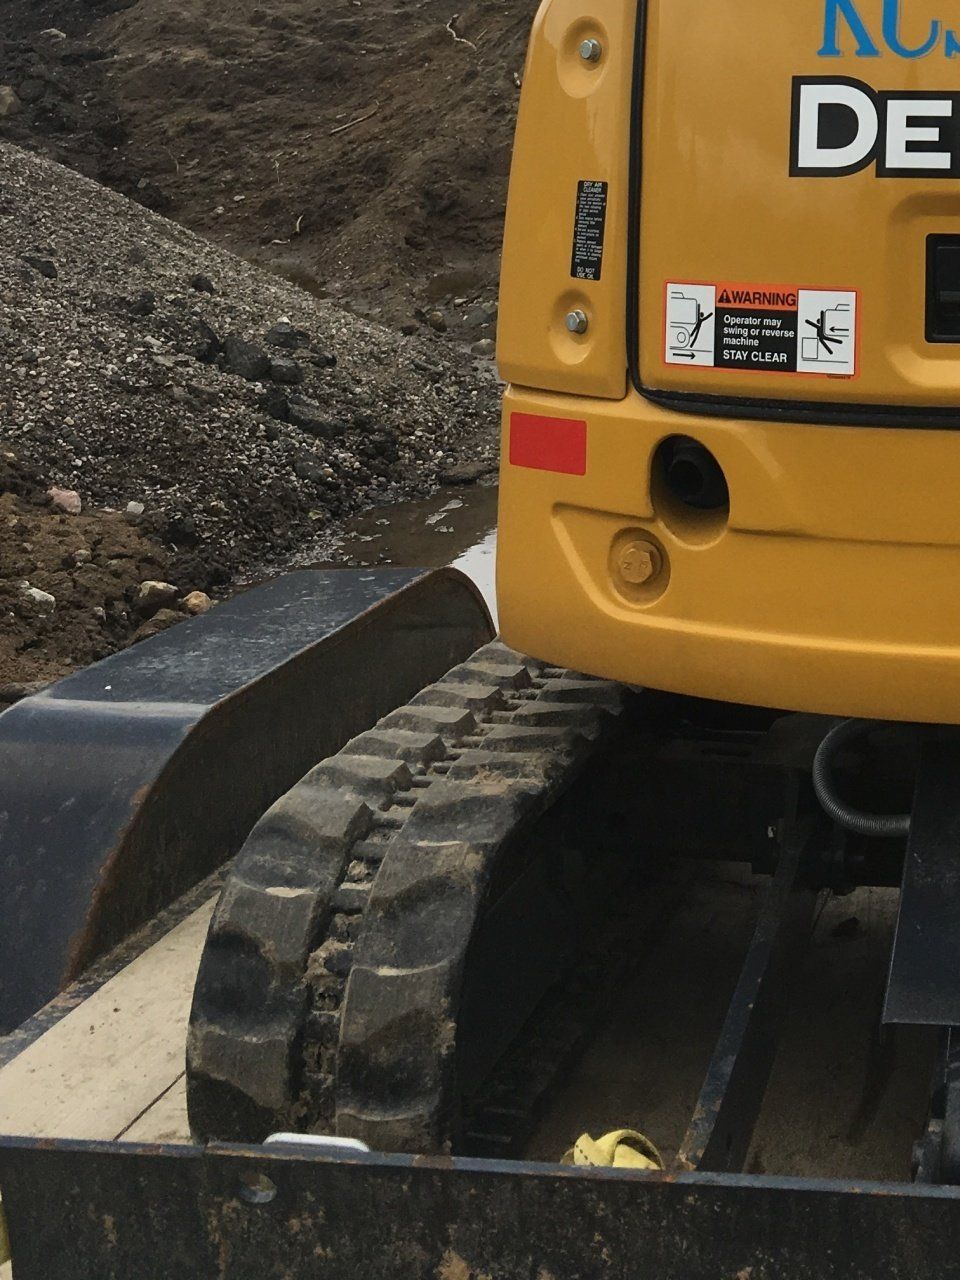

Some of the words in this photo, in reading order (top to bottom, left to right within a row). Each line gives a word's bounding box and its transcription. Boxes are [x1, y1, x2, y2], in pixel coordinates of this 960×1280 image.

[731, 290, 797, 307] WARNING
[723, 315, 762, 327] Operator
[763, 317, 782, 328] may
[723, 326, 748, 337] swing
[750, 327, 760, 336] or
[761, 328, 795, 338] reverse
[723, 336, 760, 347] machine
[723, 350, 749, 361] STAY
[750, 351, 788, 363] CLEAR
